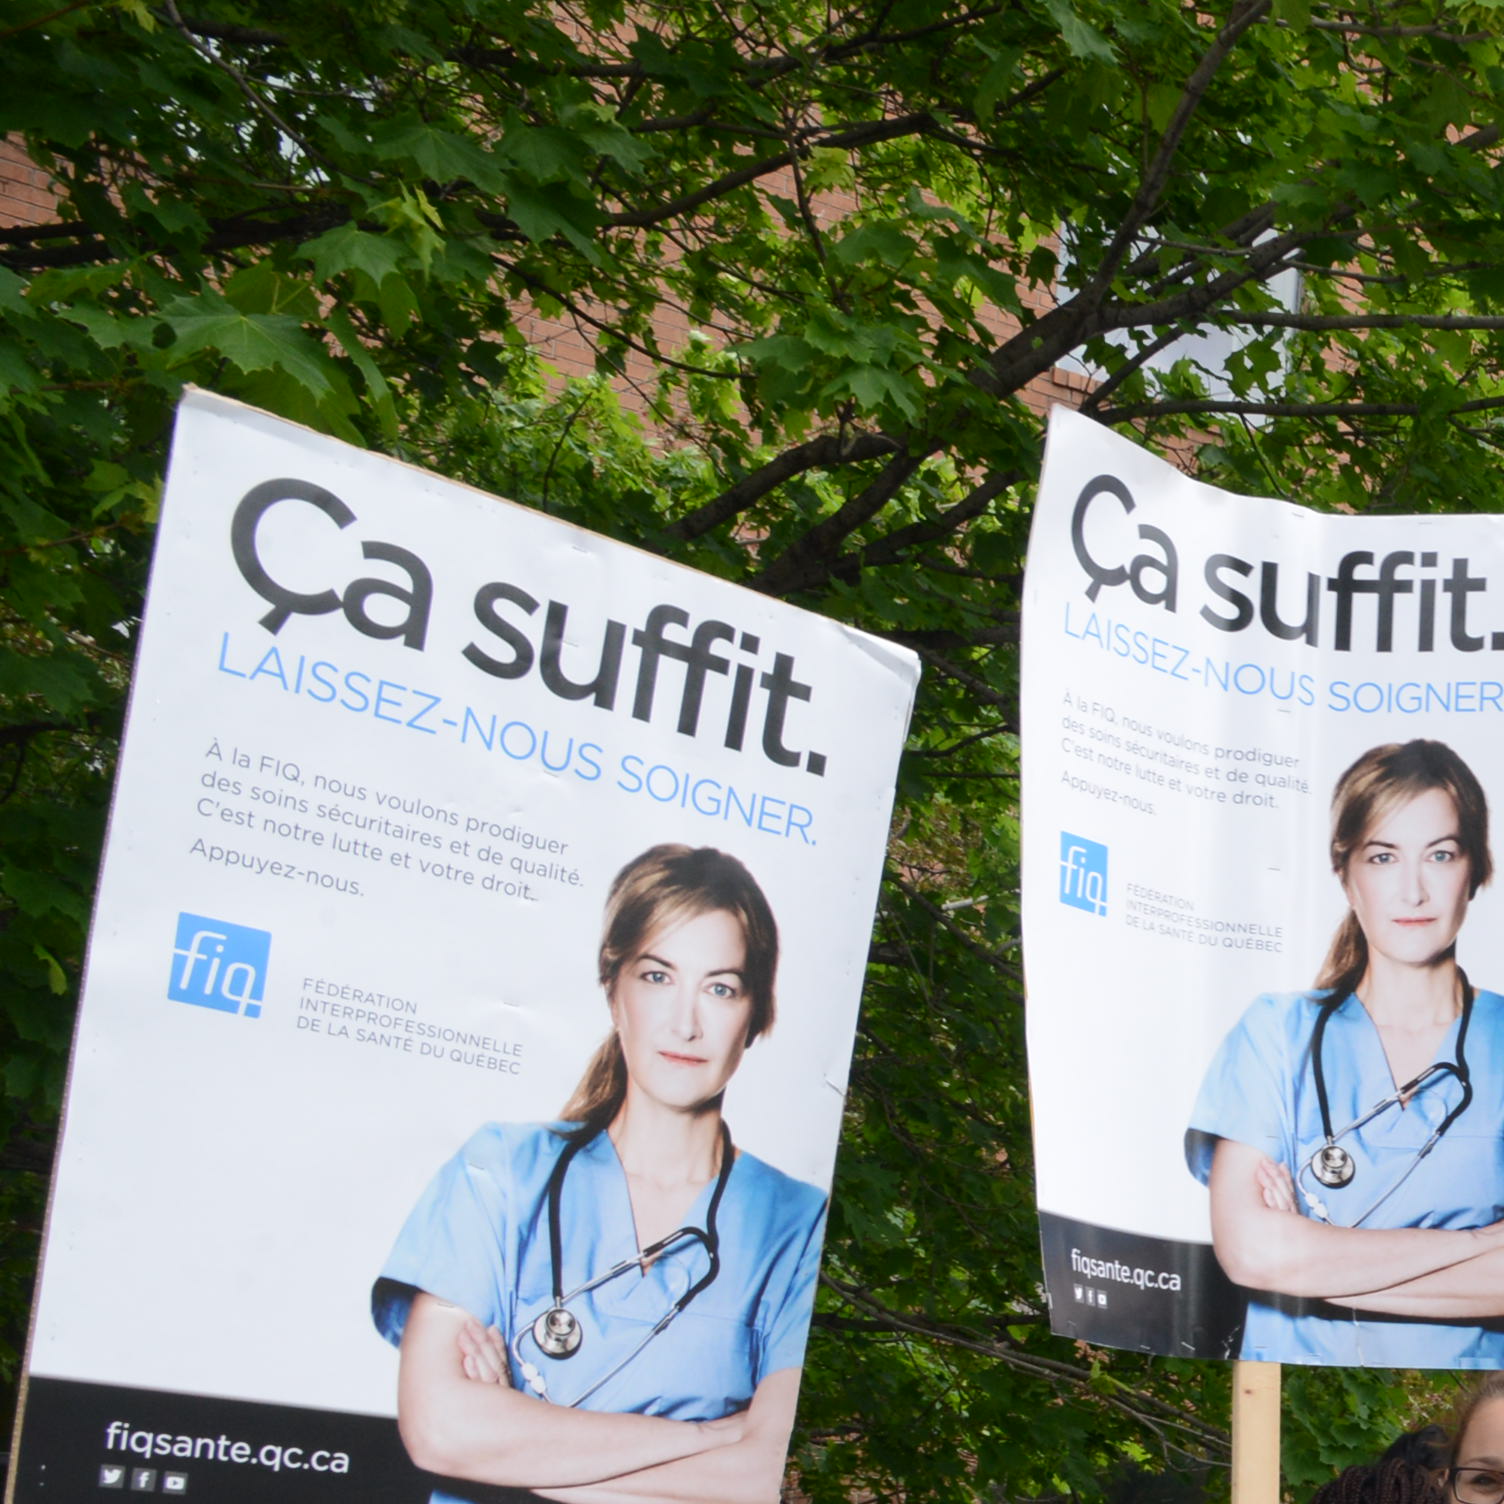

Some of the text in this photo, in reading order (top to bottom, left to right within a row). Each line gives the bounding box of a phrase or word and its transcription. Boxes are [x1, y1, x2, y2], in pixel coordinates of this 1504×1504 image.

[1071, 474, 1178, 613] Ça
[230, 476, 828, 778] Ça suffit.
[1064, 602, 1315, 706] LAISSEZ-NOUS
[217, 630, 818, 847] LAISSEZ-NOUS SOIGNER.
[1062, 714, 1312, 795] des soins sécuritaires et de qualité.
[1078, 696, 1088, 713] la
[1123, 716, 1153, 737] nous
[1157, 730, 1209, 756] voulons
[1215, 747, 1300, 768] prodiguer
[205, 737, 569, 856] À la FIQ, nous voulons prodiguer
[1061, 770, 1157, 816] Appuyez-nous.
[1097, 753, 1132, 775] notre
[1135, 761, 1165, 787] lutte
[1168, 778, 1182, 793] et
[1187, 784, 1226, 804] votre
[1233, 790, 1280, 809] droit.
[196, 797, 540, 901] C'est notre lutte et votre droit.
[201, 769, 585, 888] des soins sécuritaires et de qualité.
[189, 837, 365, 897] Appuyez-nous.
[1060, 845, 1107, 915] fiq
[173, 929, 263, 1016] fiq
[1199, 933, 1218, 947] DU
[1222, 937, 1283, 953] QUÉBEC
[299, 997, 523, 1058] INTERPROFESSIONNELLE
[302, 977, 418, 1015] FÉDÉRATION
[296, 1015, 522, 1076] DE LA SANTÉ DU QUÉBEC
[1071, 1248, 1182, 1292] fiqsante.qc.ca
[105, 1421, 350, 1474] fiqsante.qc.ca
